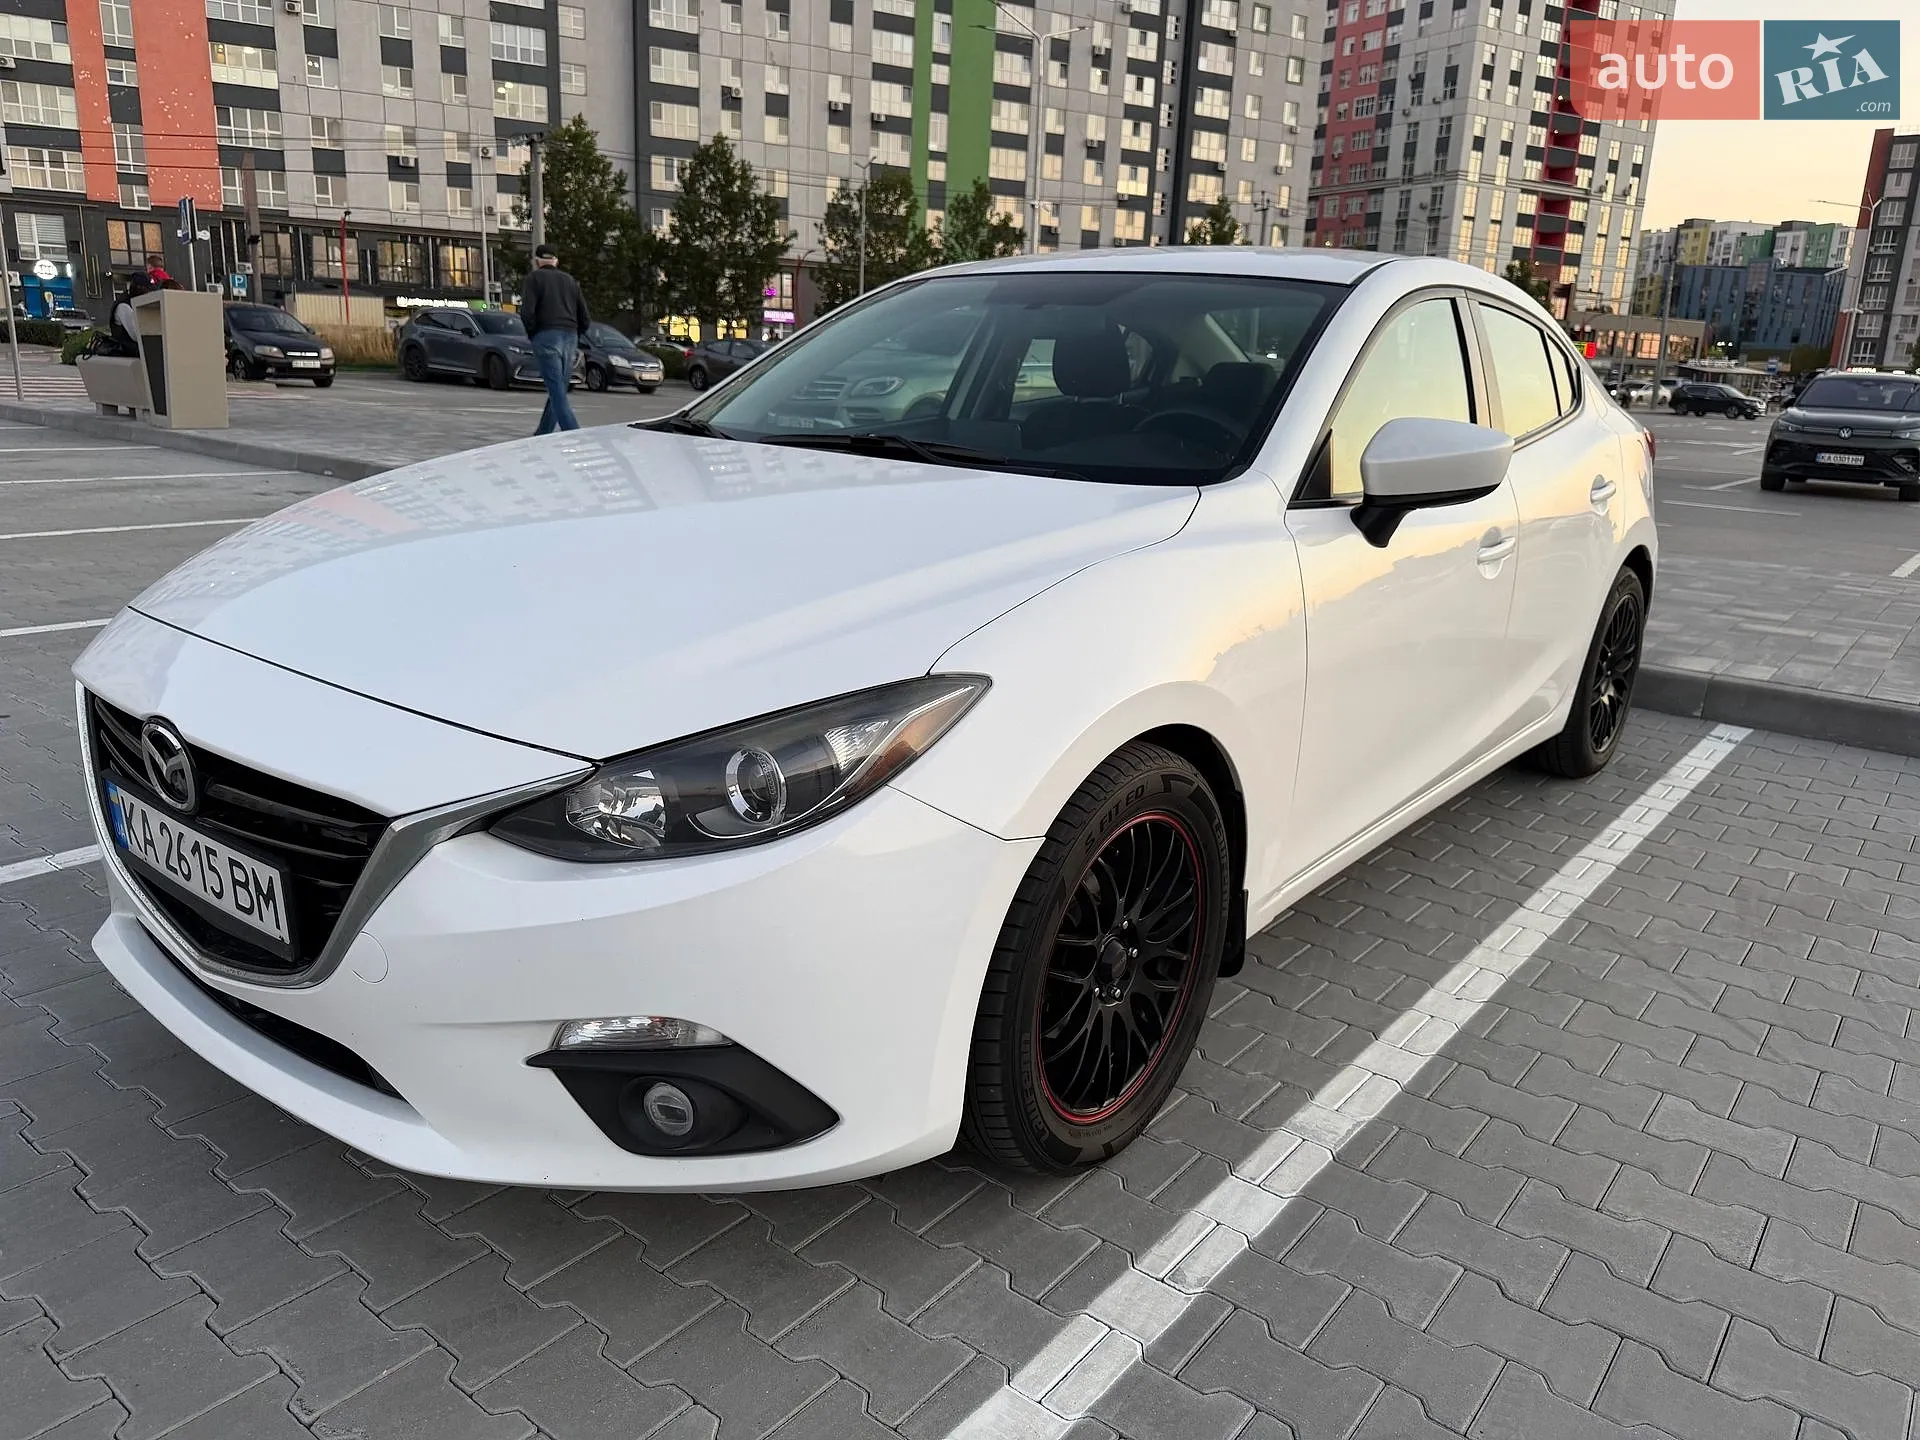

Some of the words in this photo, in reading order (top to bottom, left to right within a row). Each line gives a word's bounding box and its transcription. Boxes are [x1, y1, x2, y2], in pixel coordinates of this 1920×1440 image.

[235, 276, 244, 287] P
[1085, 831, 1095, 854] S
[1100, 803, 1121, 833] FIT
[120, 795, 160, 865] KA
[159, 821, 224, 900] 2615
[228, 856, 281, 931] BM
